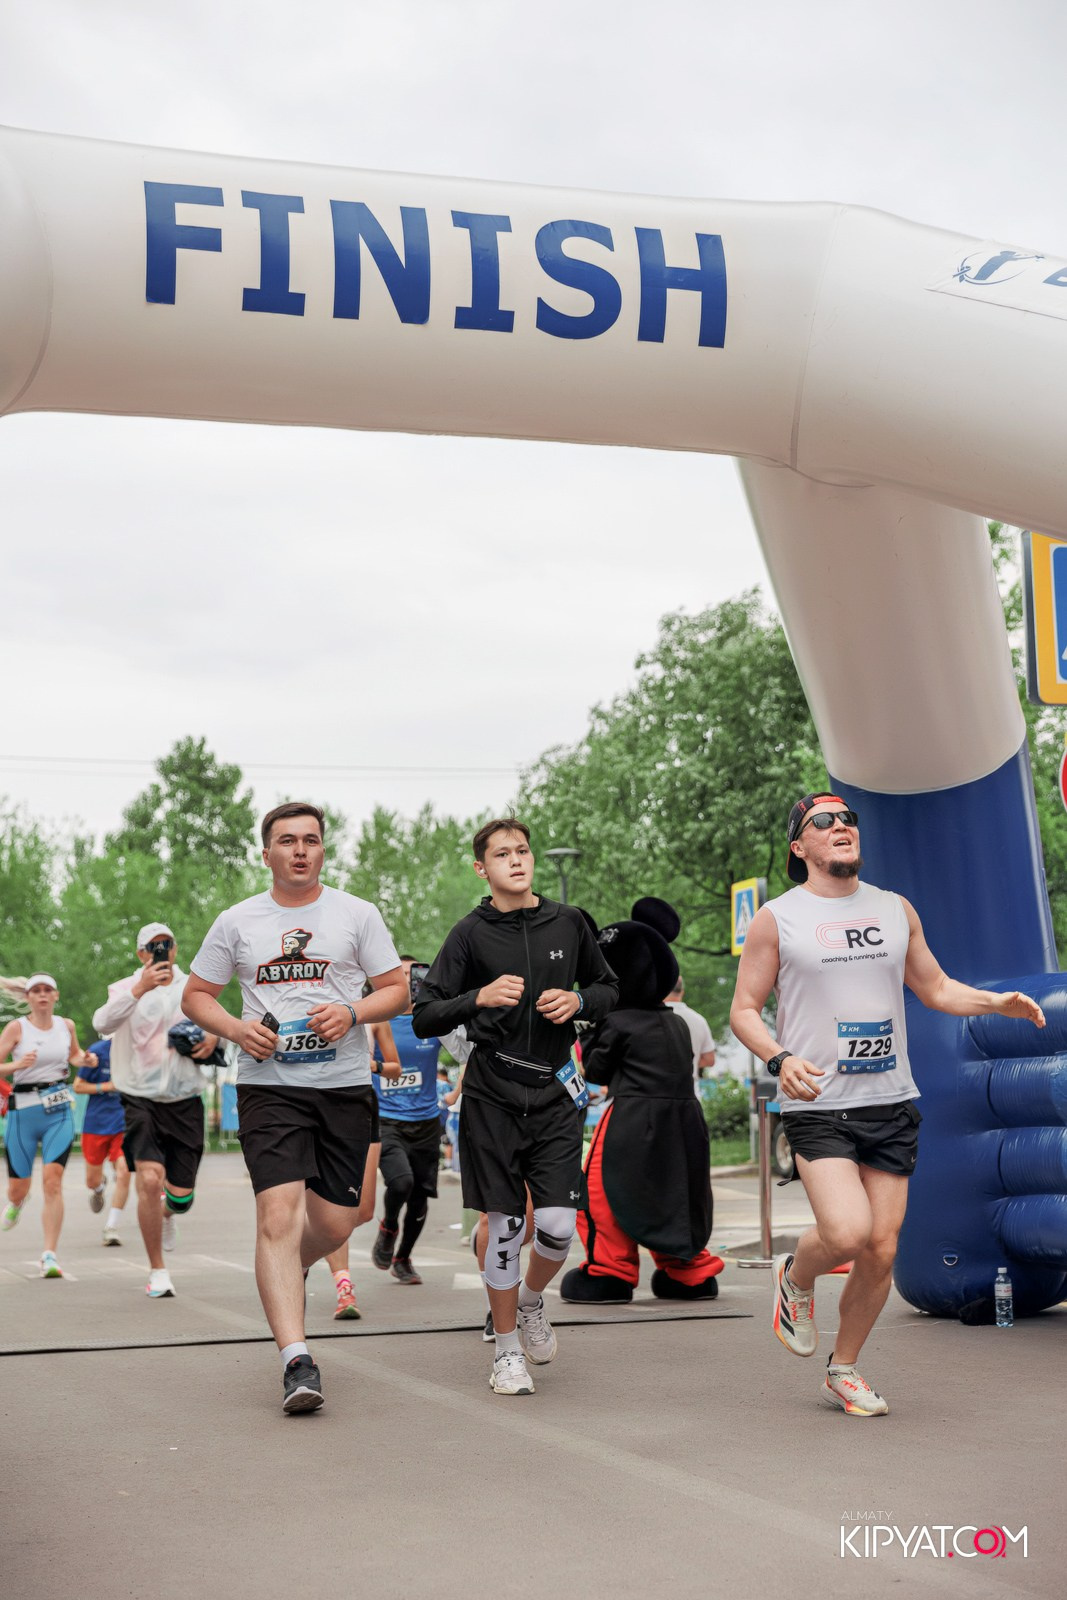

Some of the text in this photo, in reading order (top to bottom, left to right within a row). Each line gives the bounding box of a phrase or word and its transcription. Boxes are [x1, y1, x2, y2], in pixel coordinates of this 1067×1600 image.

[144, 181, 728, 349] FINISH
[821, 955, 848, 964] coaching
[854, 952, 876, 961] running
[875, 951, 889, 959] club
[293, 981, 324, 989] TEAM
[848, 1037, 892, 1058] 1229
